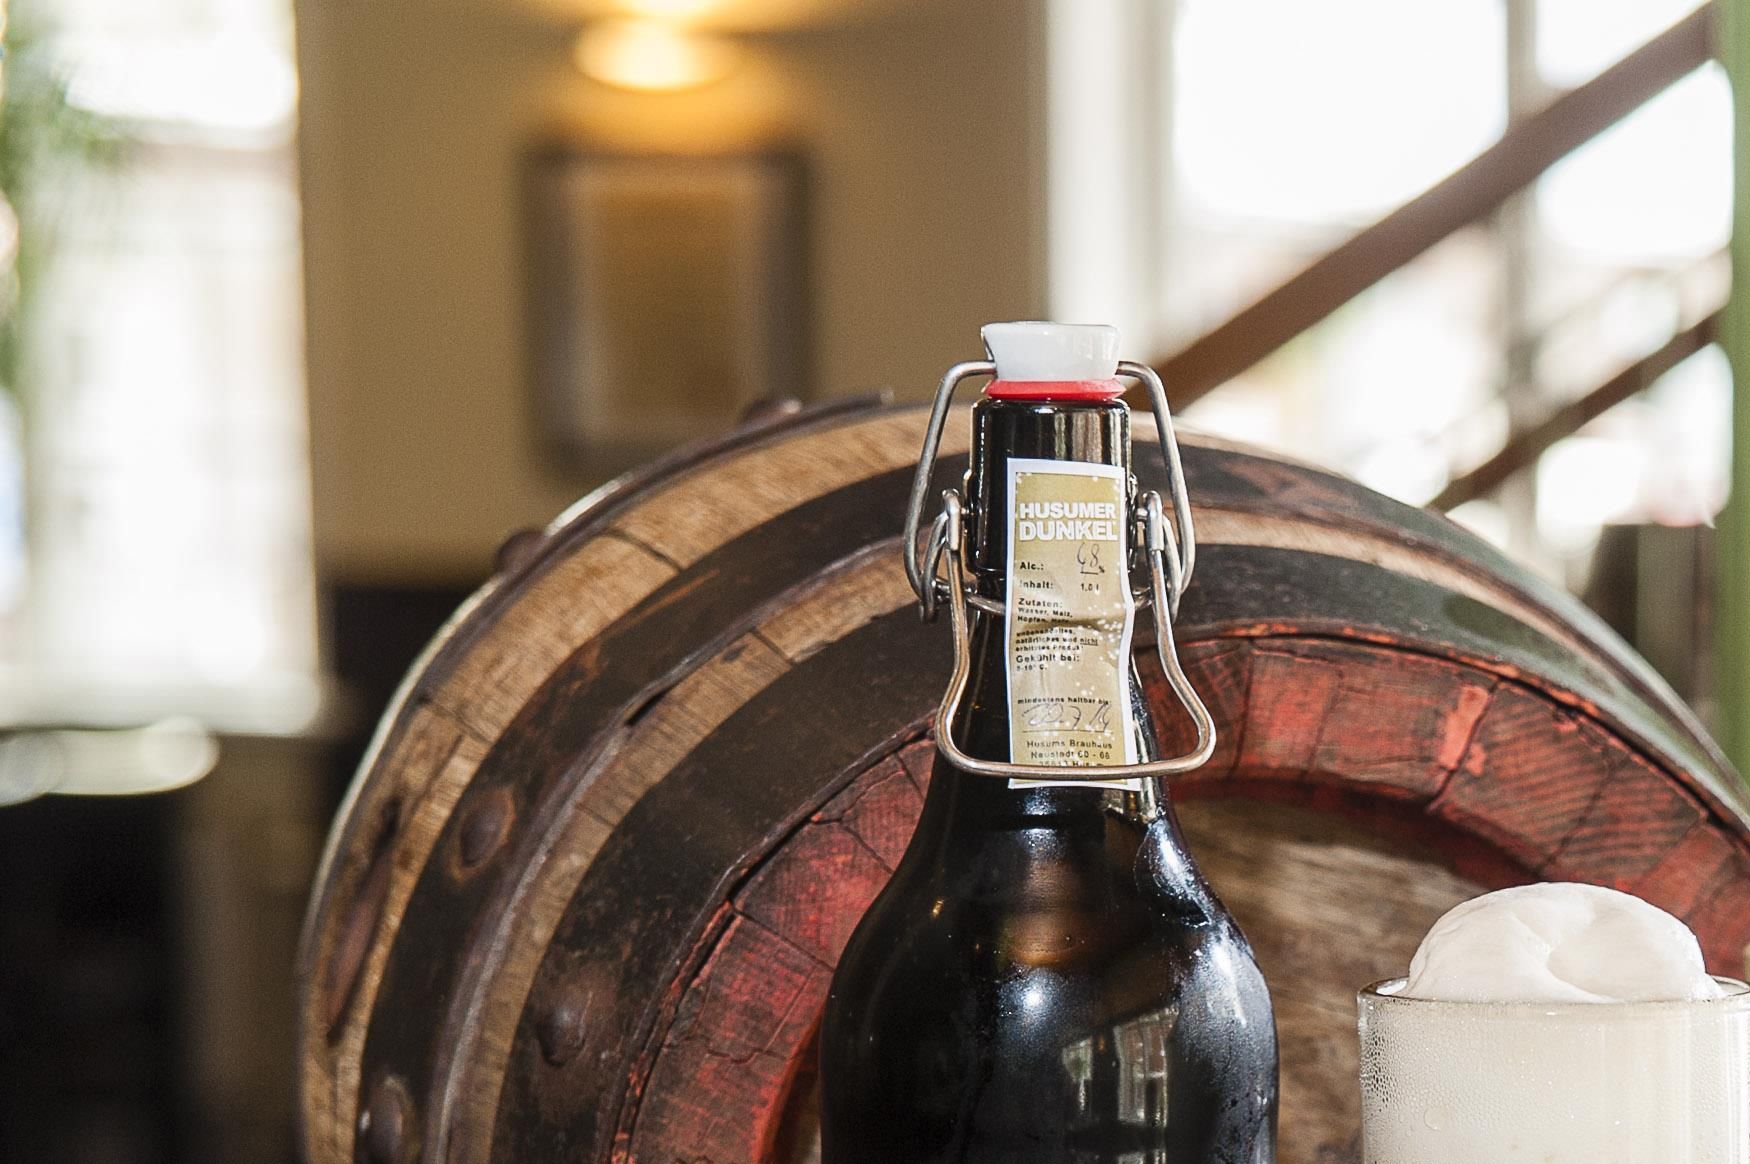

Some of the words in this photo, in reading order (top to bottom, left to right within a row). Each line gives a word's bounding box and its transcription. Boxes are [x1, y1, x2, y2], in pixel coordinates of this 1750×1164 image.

[1019, 502, 1117, 519] HUSUMER
[1019, 520, 1118, 541] DUNKEL
[1020, 561, 1044, 571] Alc.:
[1018, 597, 1063, 609] Zutaten:
[1060, 654, 1080, 662] bei:
